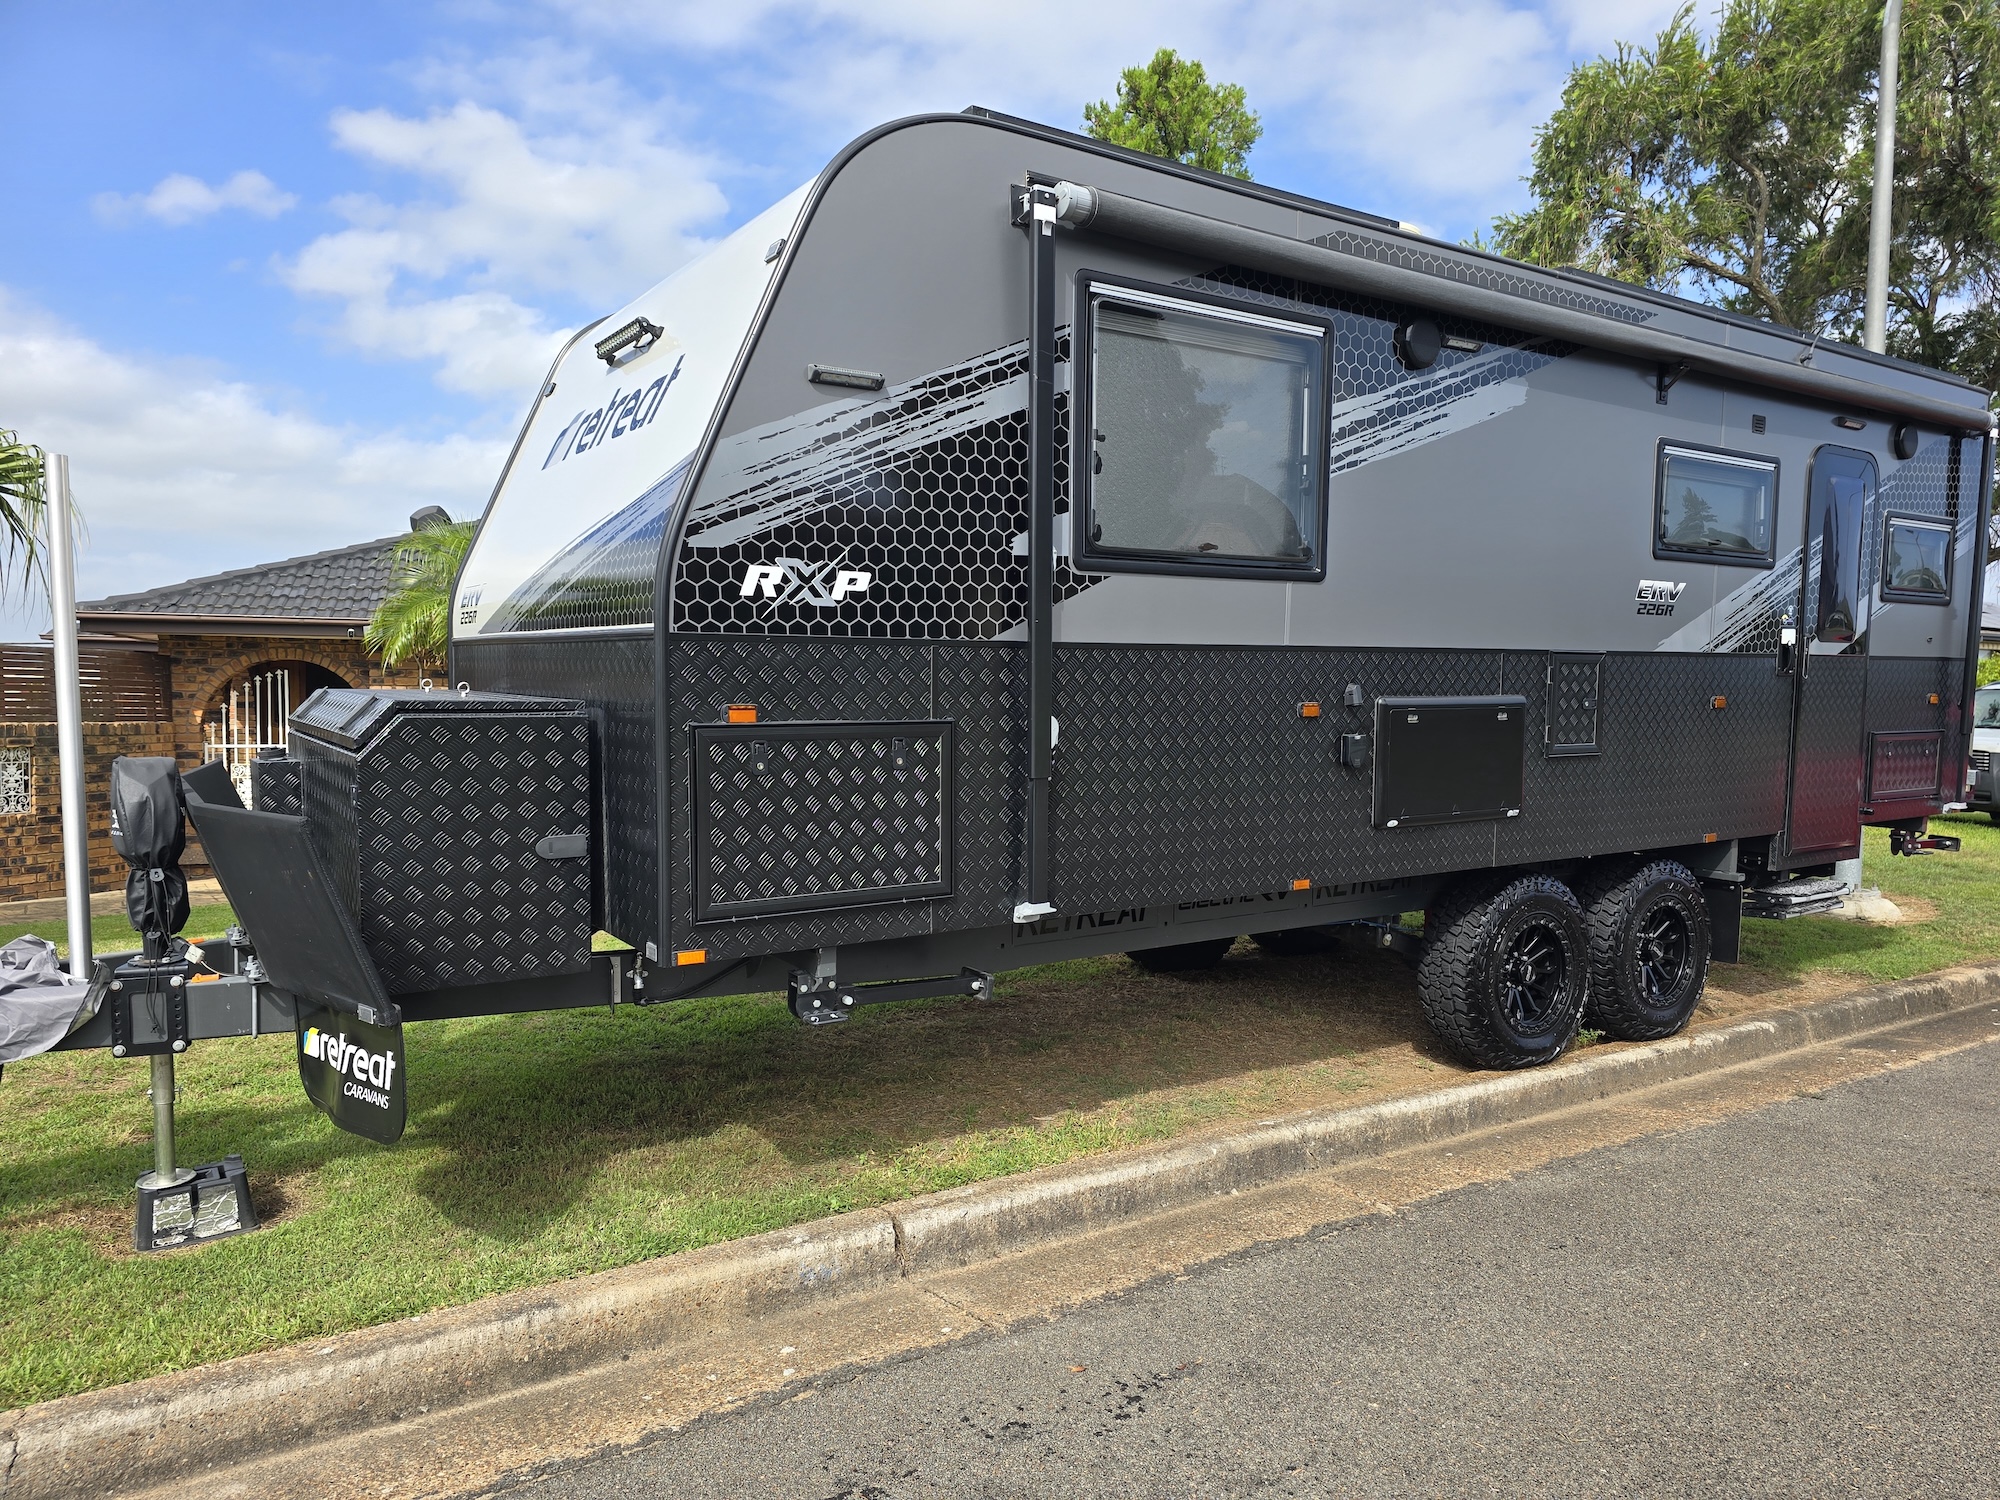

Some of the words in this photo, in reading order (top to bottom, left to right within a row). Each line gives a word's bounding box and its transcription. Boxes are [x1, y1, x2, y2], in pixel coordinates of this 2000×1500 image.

[562, 353, 686, 461] retreat
[739, 547, 872, 619] RXP
[1635, 580, 1686, 602] ERV
[1637, 603, 1674, 616] 226R
[320, 1032, 396, 1091] retreat
[344, 1082, 390, 1109] CARAVANS
